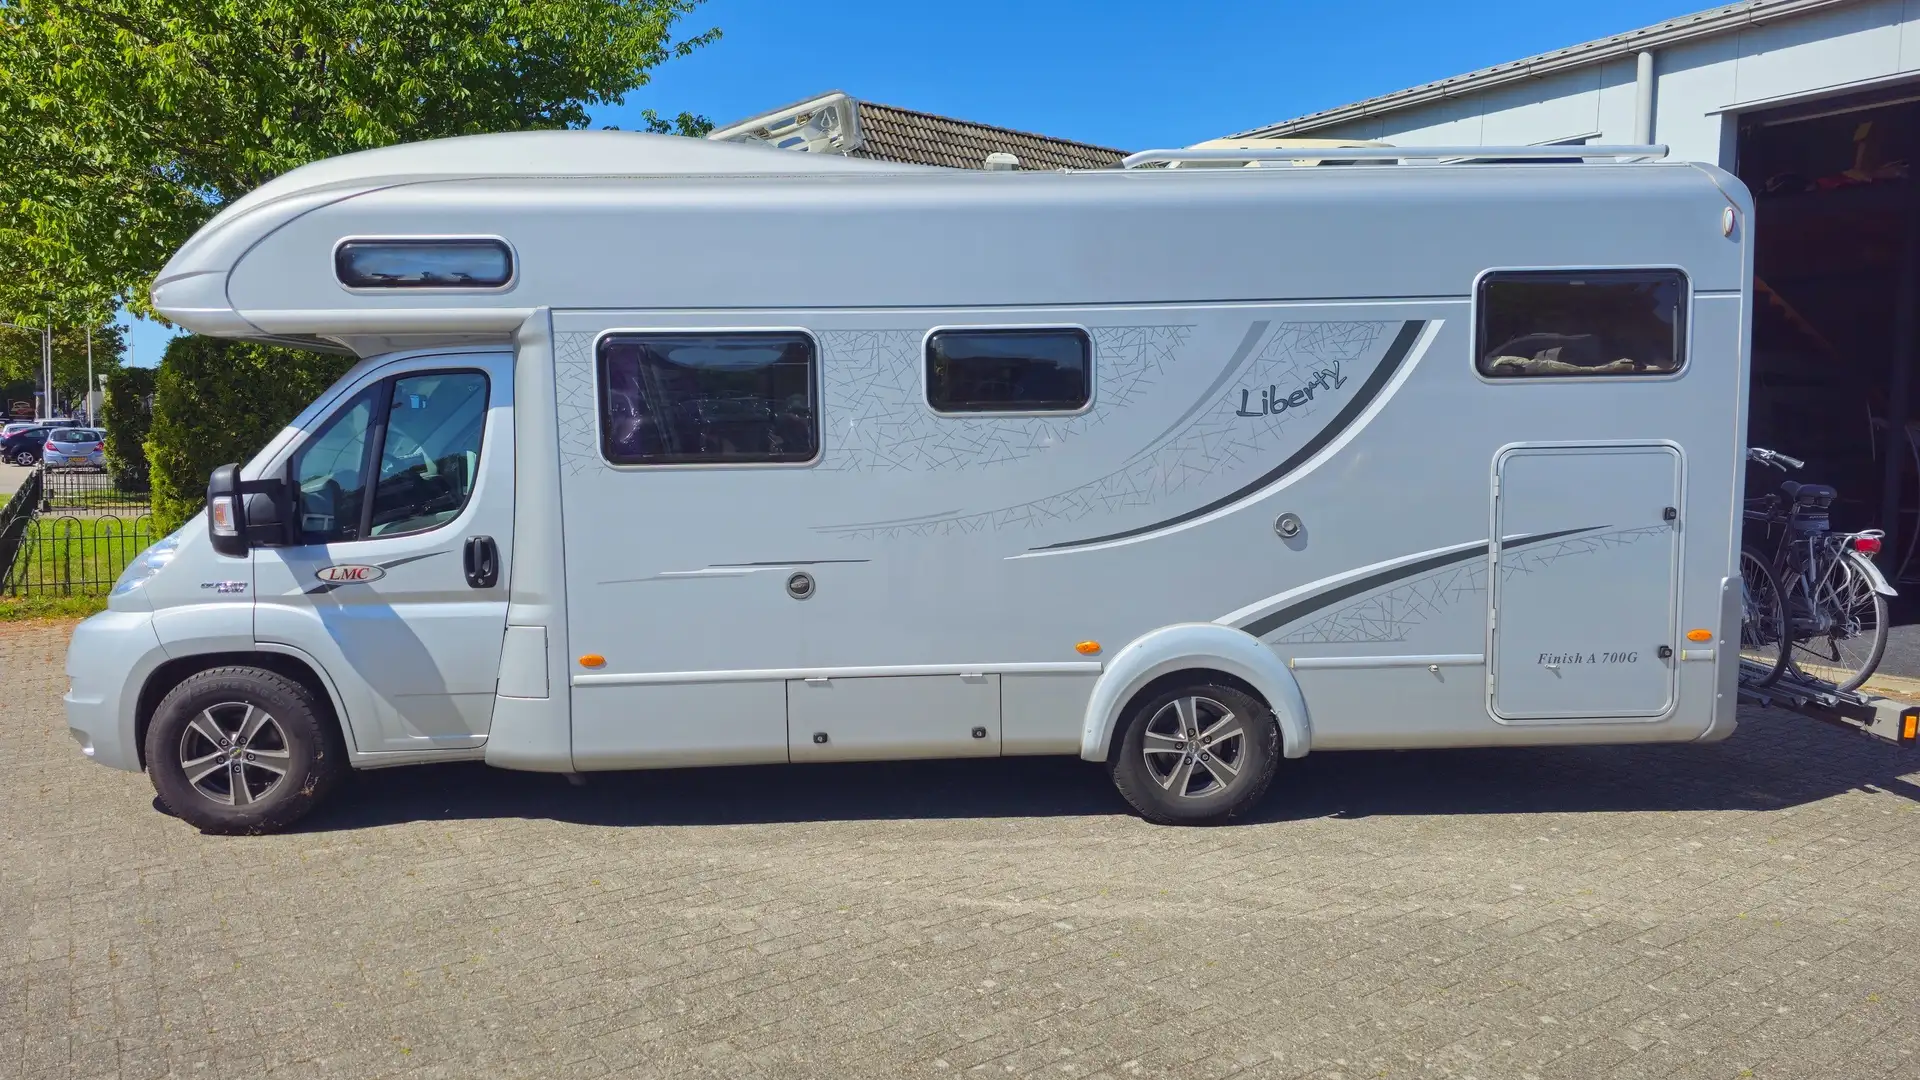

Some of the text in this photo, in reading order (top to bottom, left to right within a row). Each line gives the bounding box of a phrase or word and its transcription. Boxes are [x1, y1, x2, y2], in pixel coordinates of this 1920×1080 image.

[1236, 360, 1347, 417] Liberty
[330, 568, 369, 580] LMC
[1537, 652, 1638, 664] Finish A 700G
